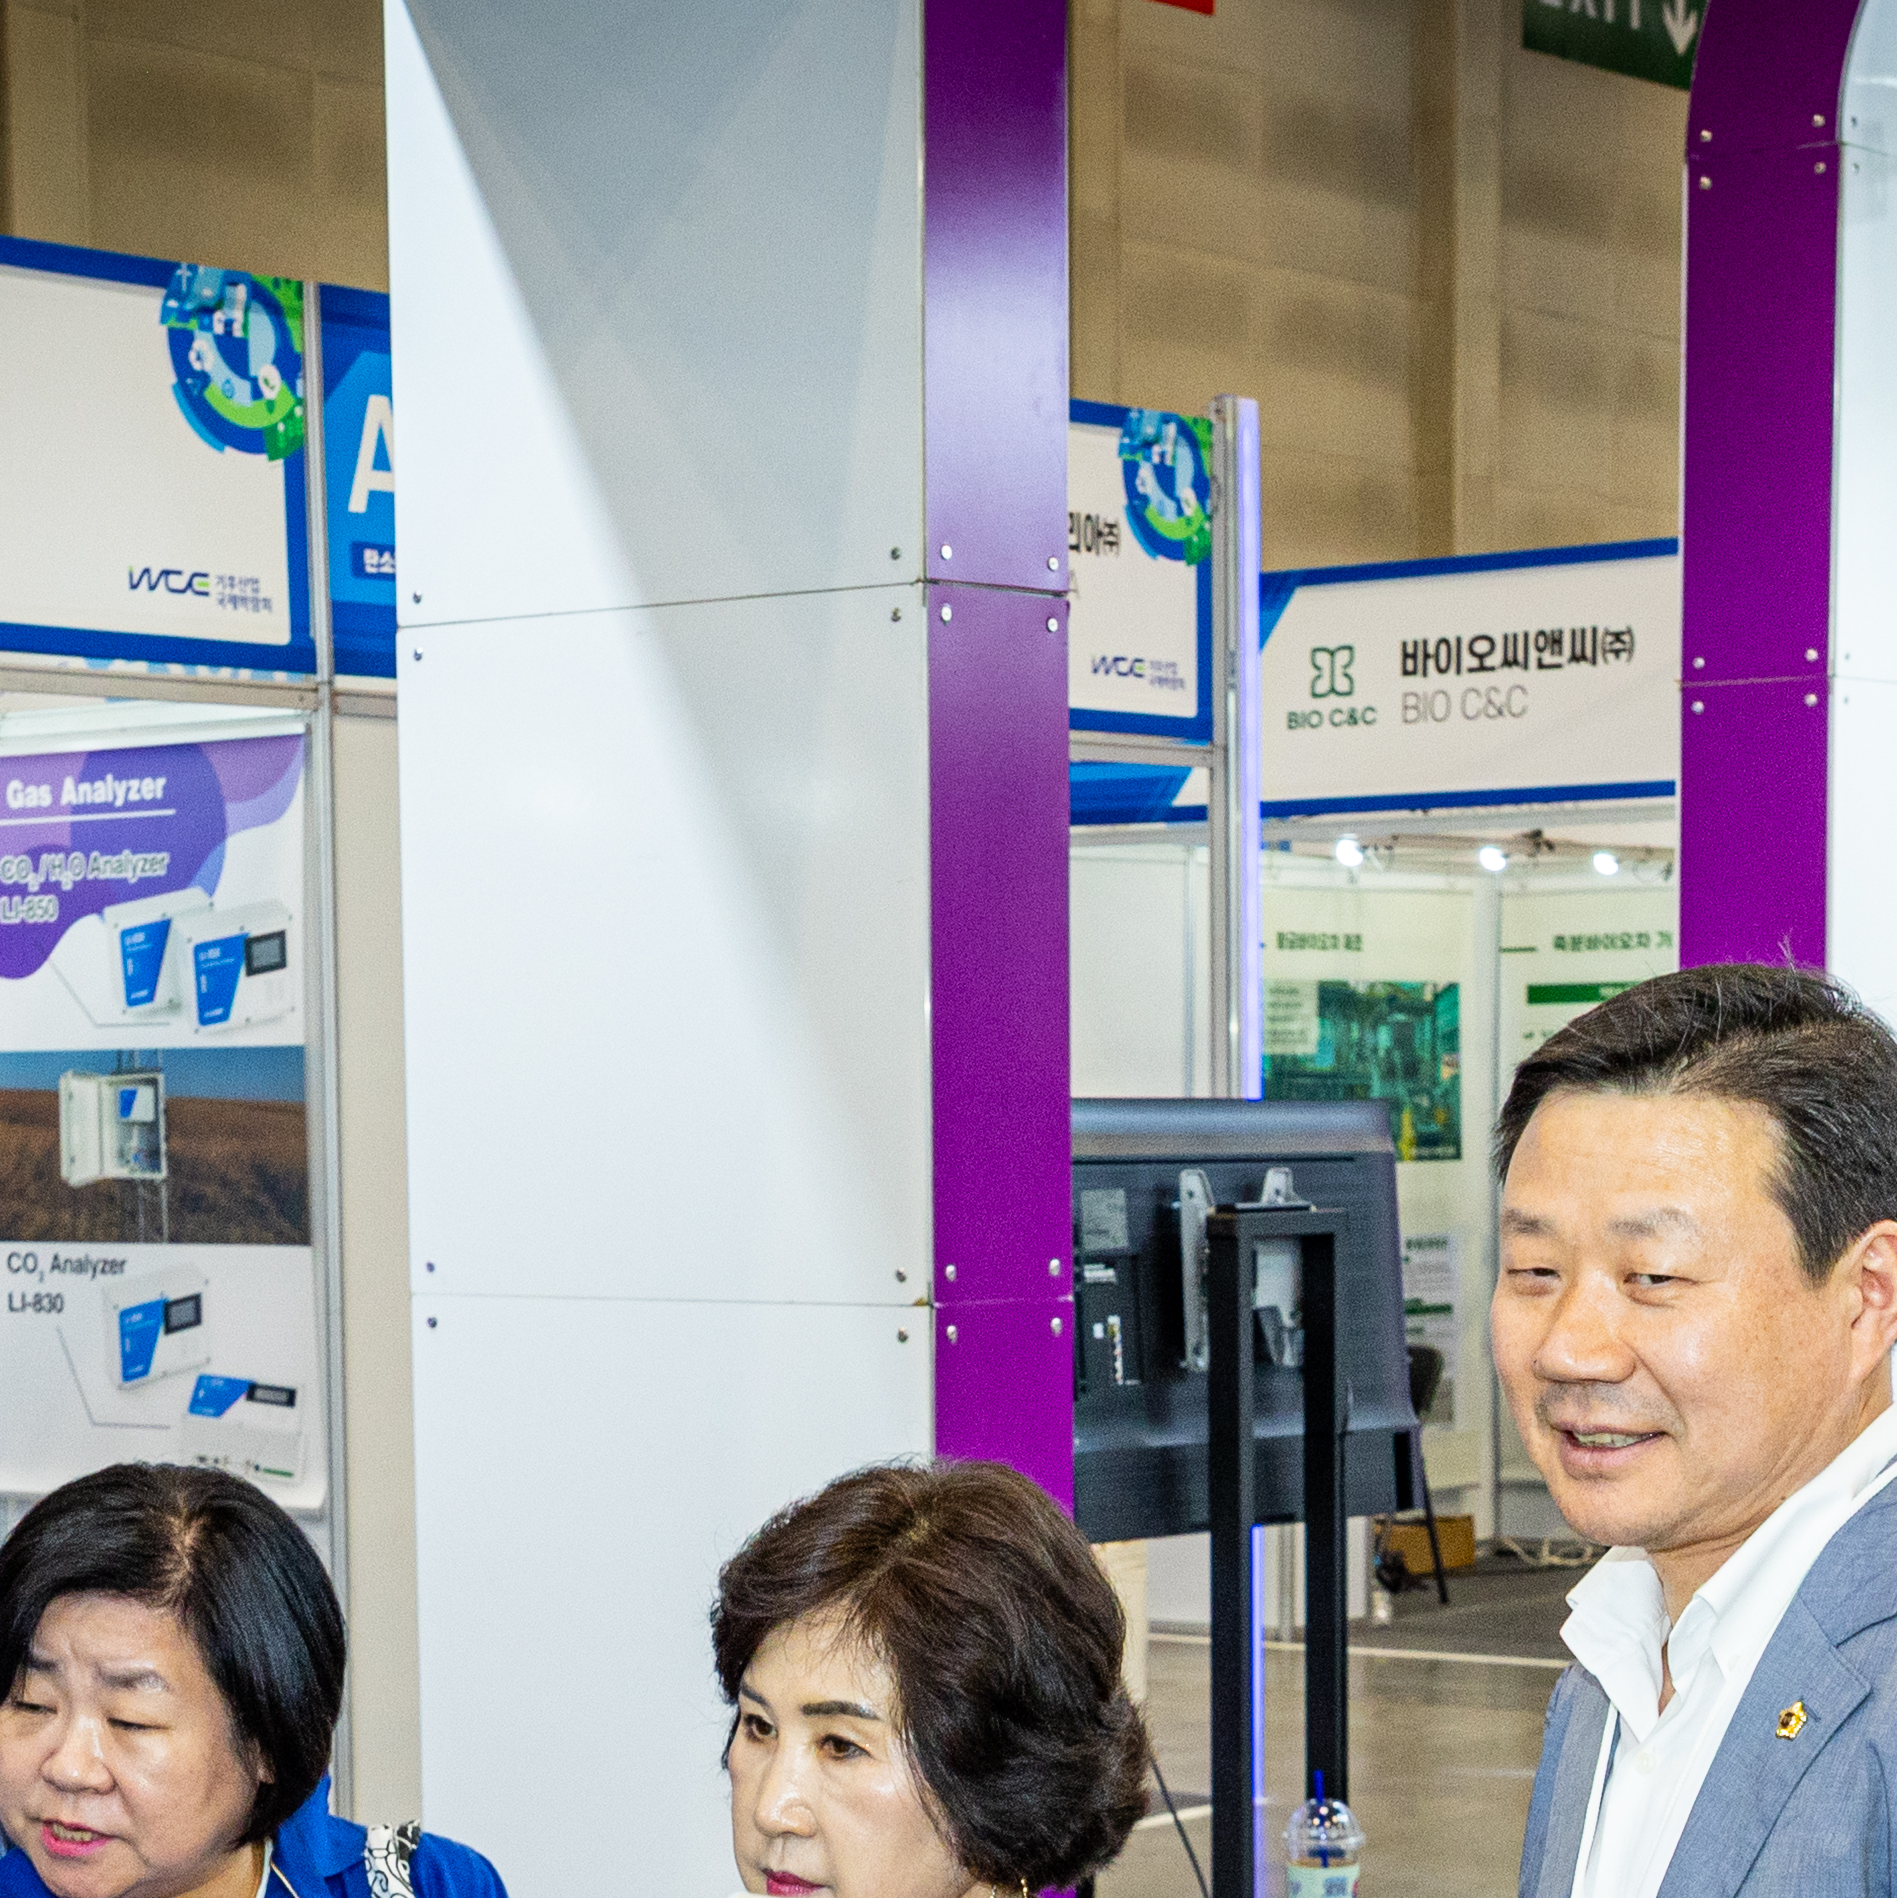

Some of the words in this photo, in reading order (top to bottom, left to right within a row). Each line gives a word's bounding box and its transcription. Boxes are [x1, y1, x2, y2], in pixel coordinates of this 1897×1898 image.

[128, 565, 210, 597] WCE
[1091, 655, 1146, 678] WCE
[1288, 708, 1325, 730] BIO
[1330, 705, 1377, 729] C&C
[1402, 690, 1452, 725] BIO
[1461, 685, 1529, 720] C&C
[6, 778, 52, 810] Gas
[60, 774, 166, 807] Analyzer
[89, 849, 170, 883] Analyzer
[50, 1253, 126, 1281] Analyzer
[7, 1291, 65, 1315] LI-830
